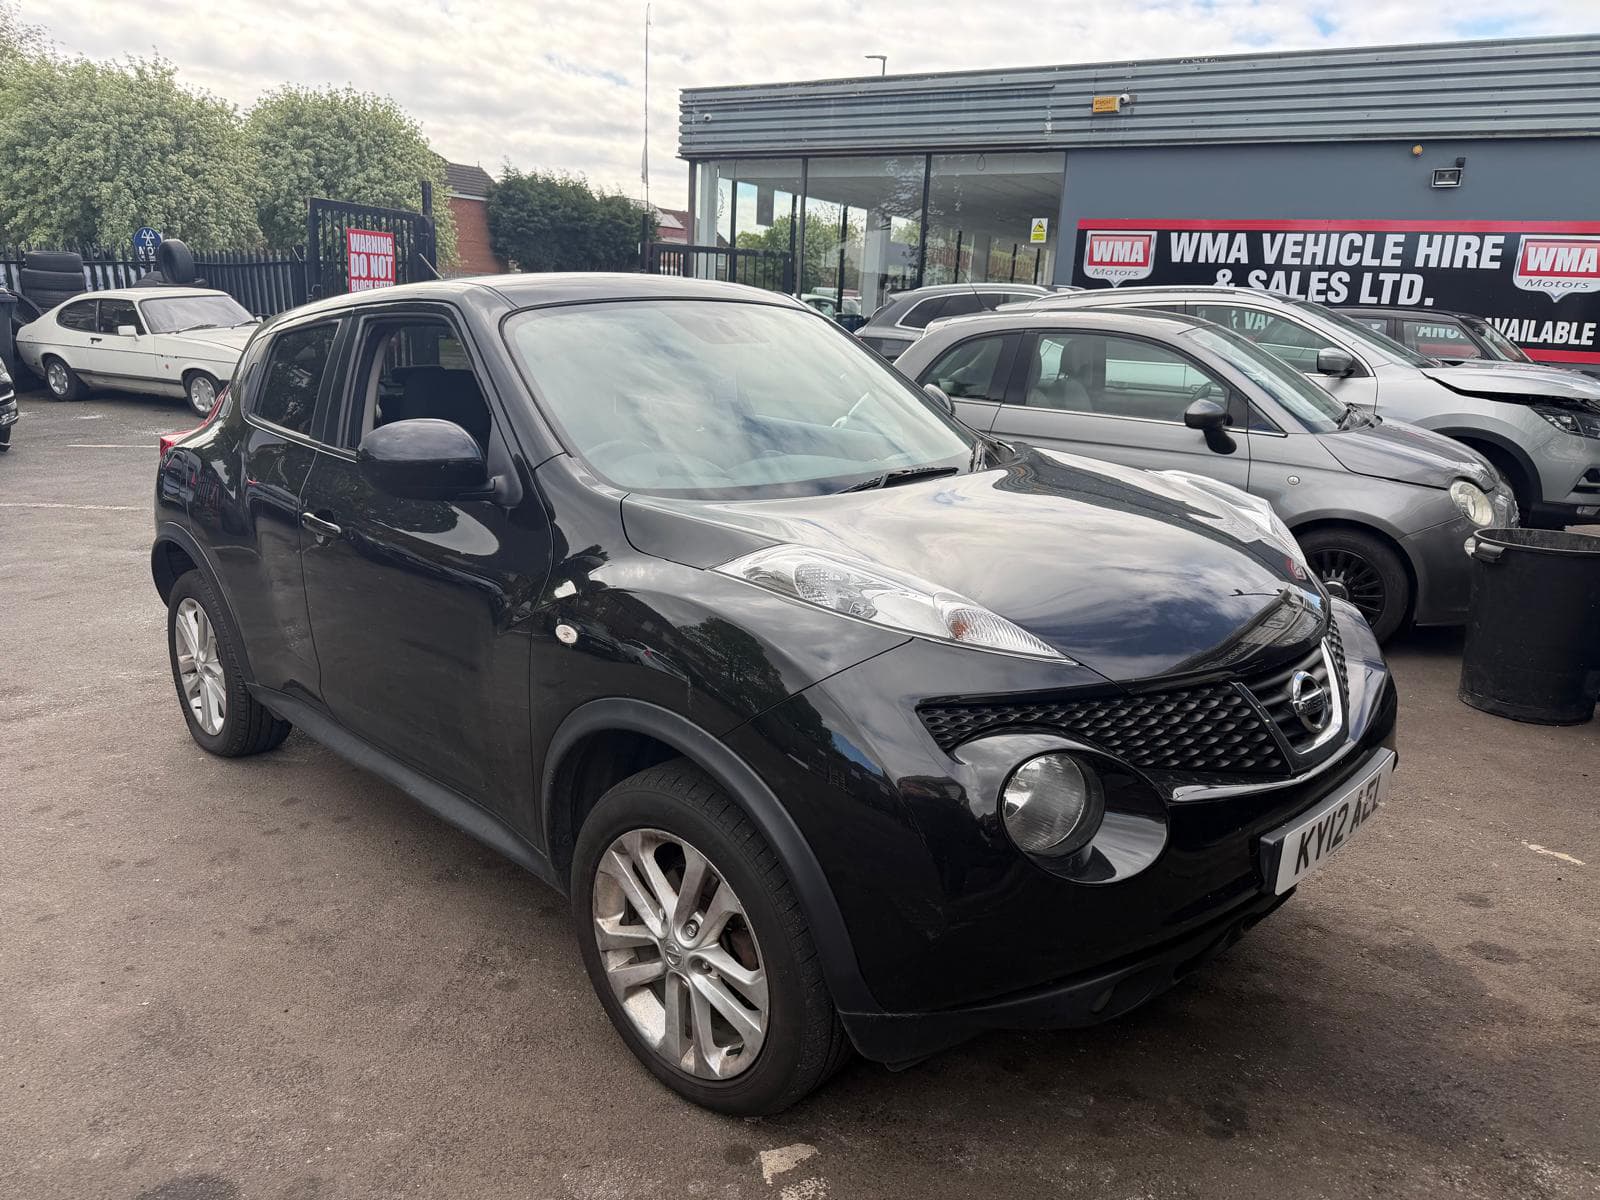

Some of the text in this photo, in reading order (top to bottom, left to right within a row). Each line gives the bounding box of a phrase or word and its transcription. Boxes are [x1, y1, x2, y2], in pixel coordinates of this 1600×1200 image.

[349, 233, 393, 255] WARNING
[1092, 240, 1144, 263] WMA
[1170, 232, 1506, 269] WMA VEHICLE HIRE
[350, 253, 393, 279] DO NOT
[1092, 267, 1139, 277] Motors
[1526, 247, 1598, 273] WMA
[1212, 269, 1434, 306] & SALES LTD.
[1524, 279, 1590, 289] Motors
[1295, 802, 1350, 875] KY12
